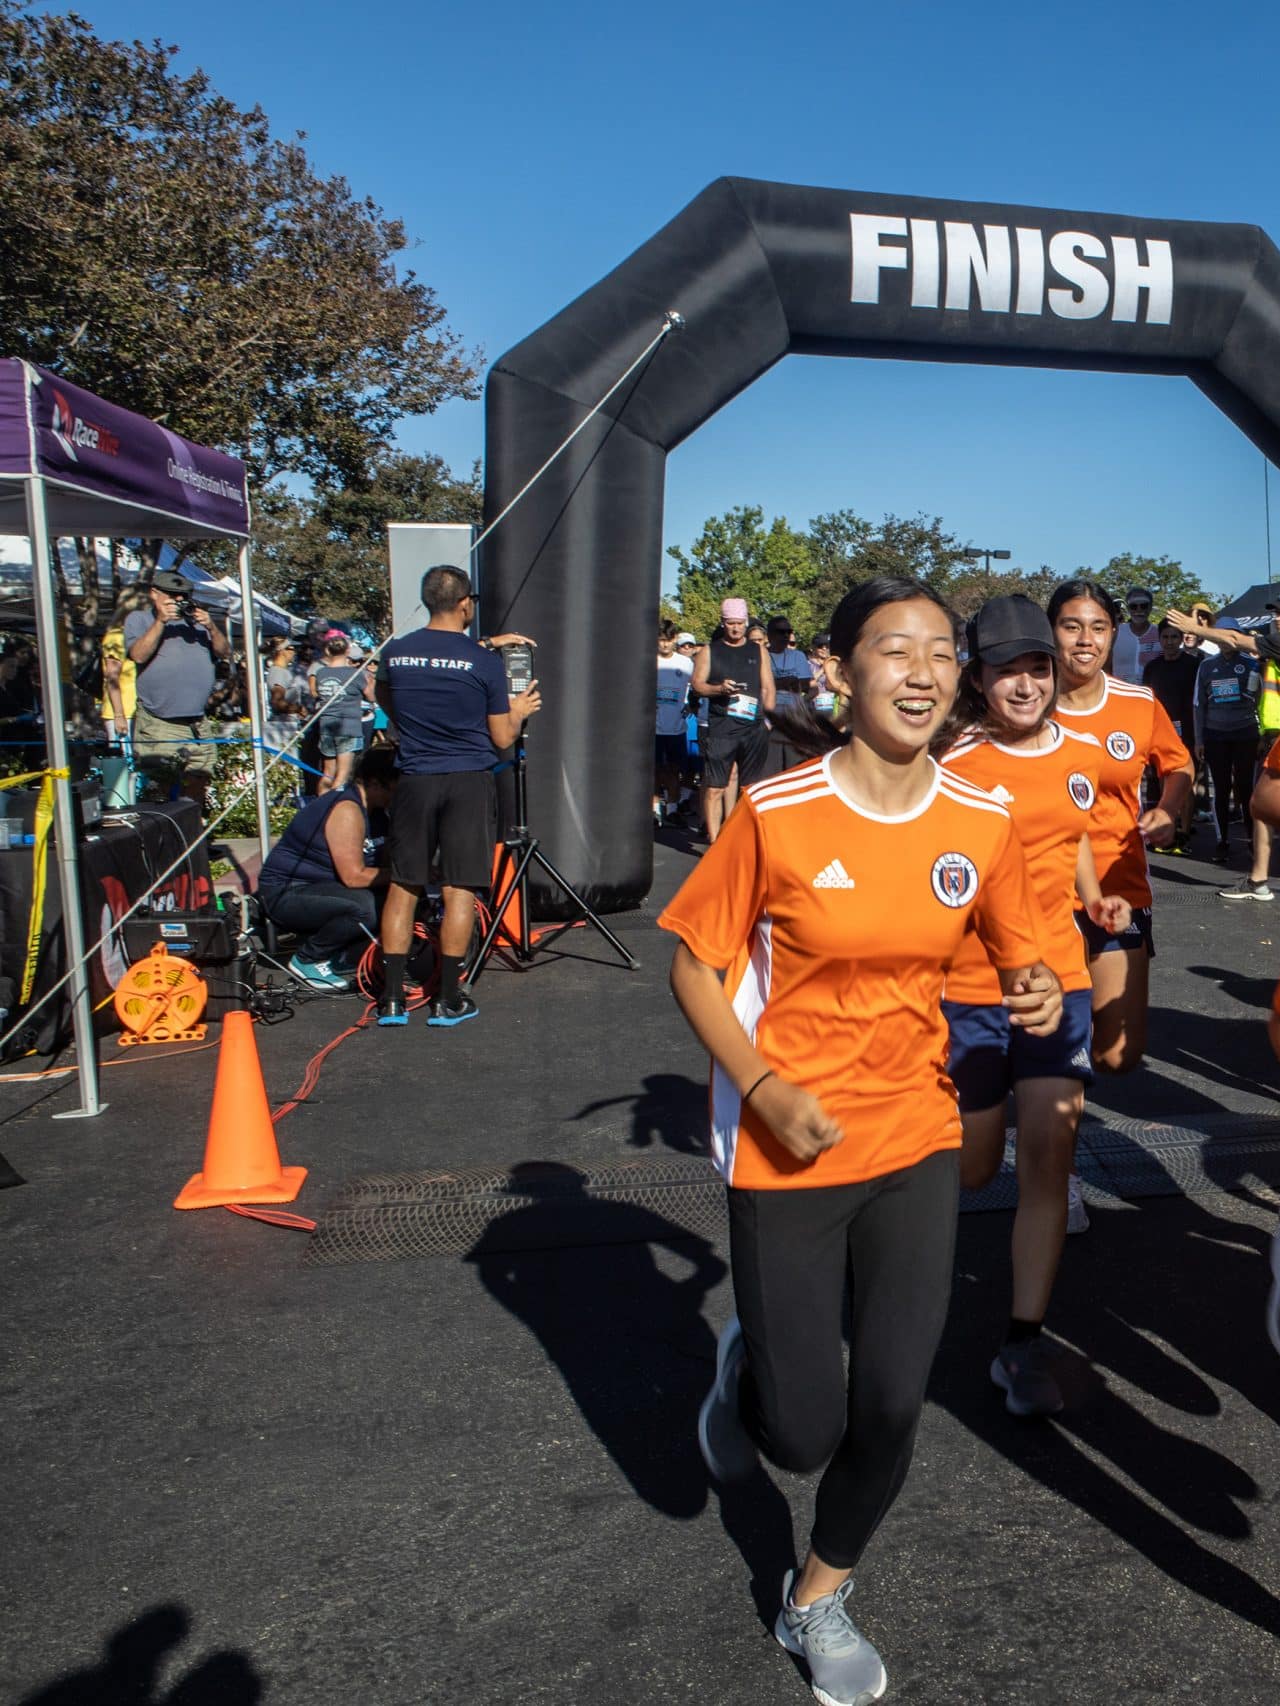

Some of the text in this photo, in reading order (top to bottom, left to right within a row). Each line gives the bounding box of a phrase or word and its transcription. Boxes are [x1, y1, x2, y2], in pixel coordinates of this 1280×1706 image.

[850, 212, 1174, 325] FINISH
[389, 656, 474, 671] EVENT STAFF
[812, 876, 855, 889] adidas
